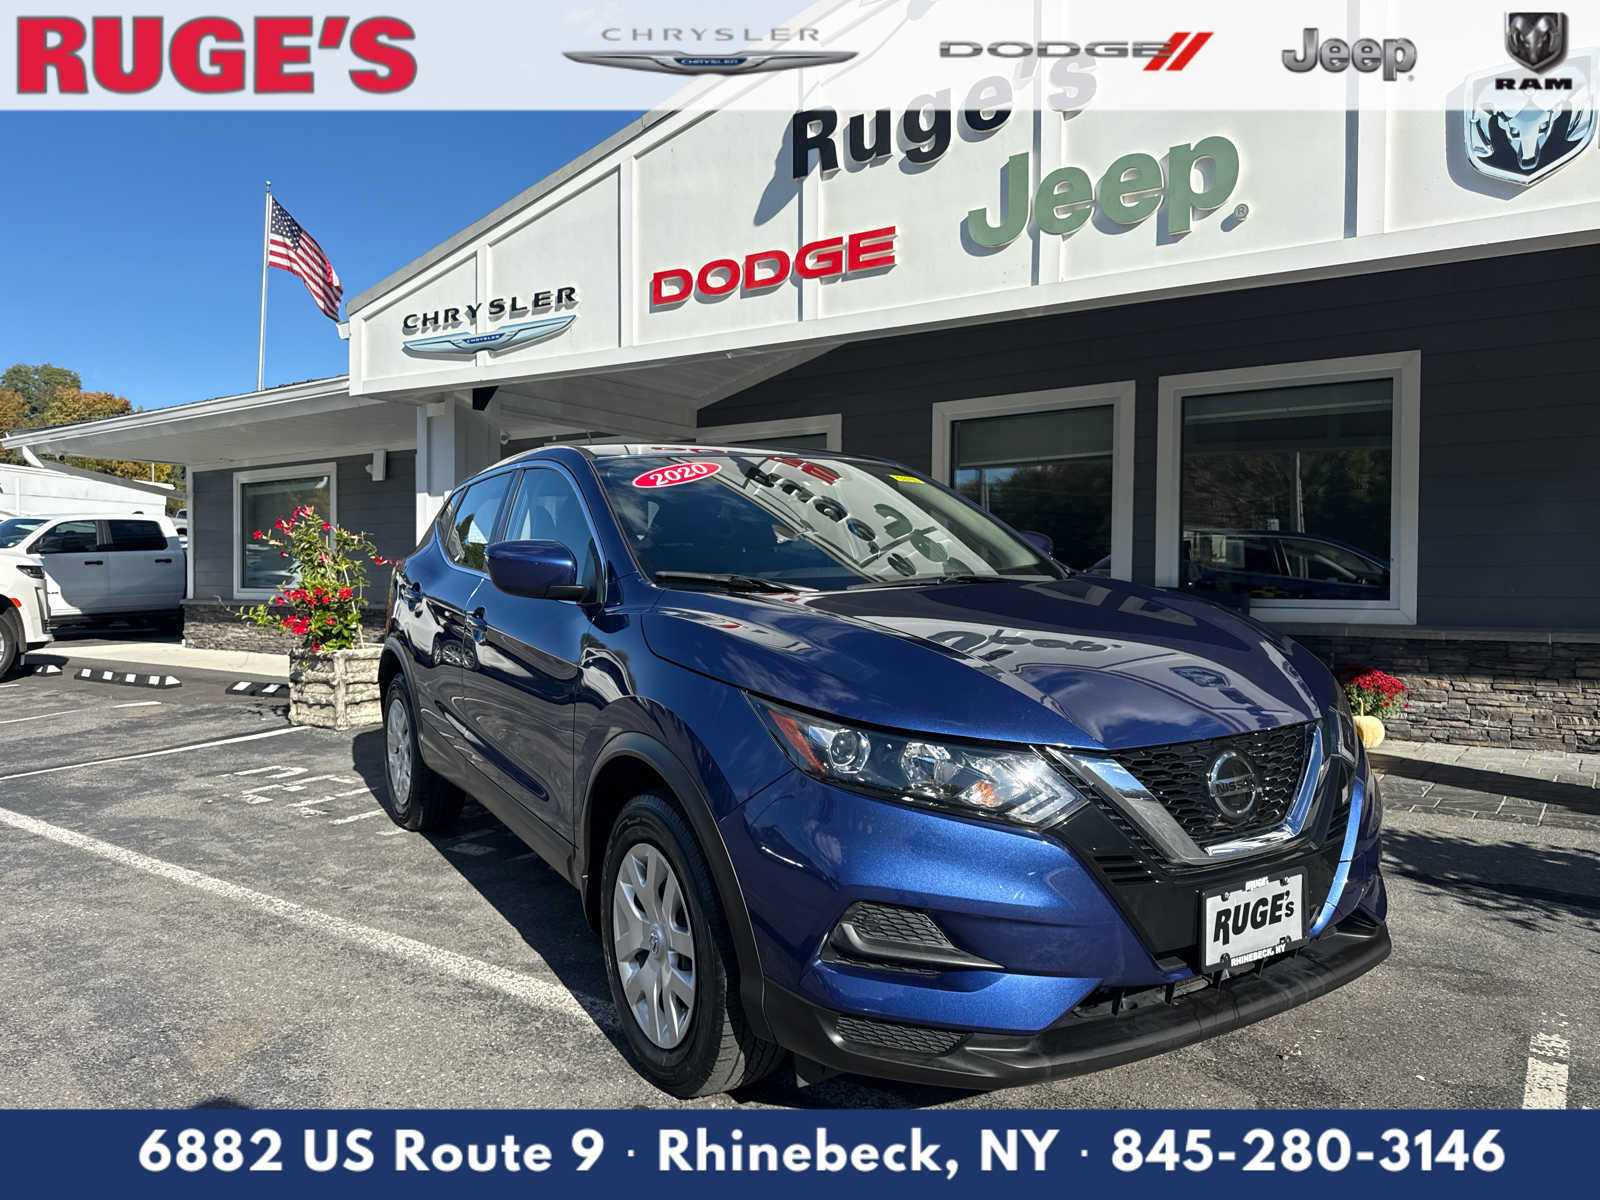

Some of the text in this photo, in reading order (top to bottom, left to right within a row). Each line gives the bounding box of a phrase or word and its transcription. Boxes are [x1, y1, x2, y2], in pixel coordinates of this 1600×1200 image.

[967, 135, 1240, 249] Jeep
[651, 226, 897, 306] DODGE
[403, 286, 577, 330] CHRYSLER
[649, 464, 708, 486] 2020
[1275, 944, 1287, 955] NY
